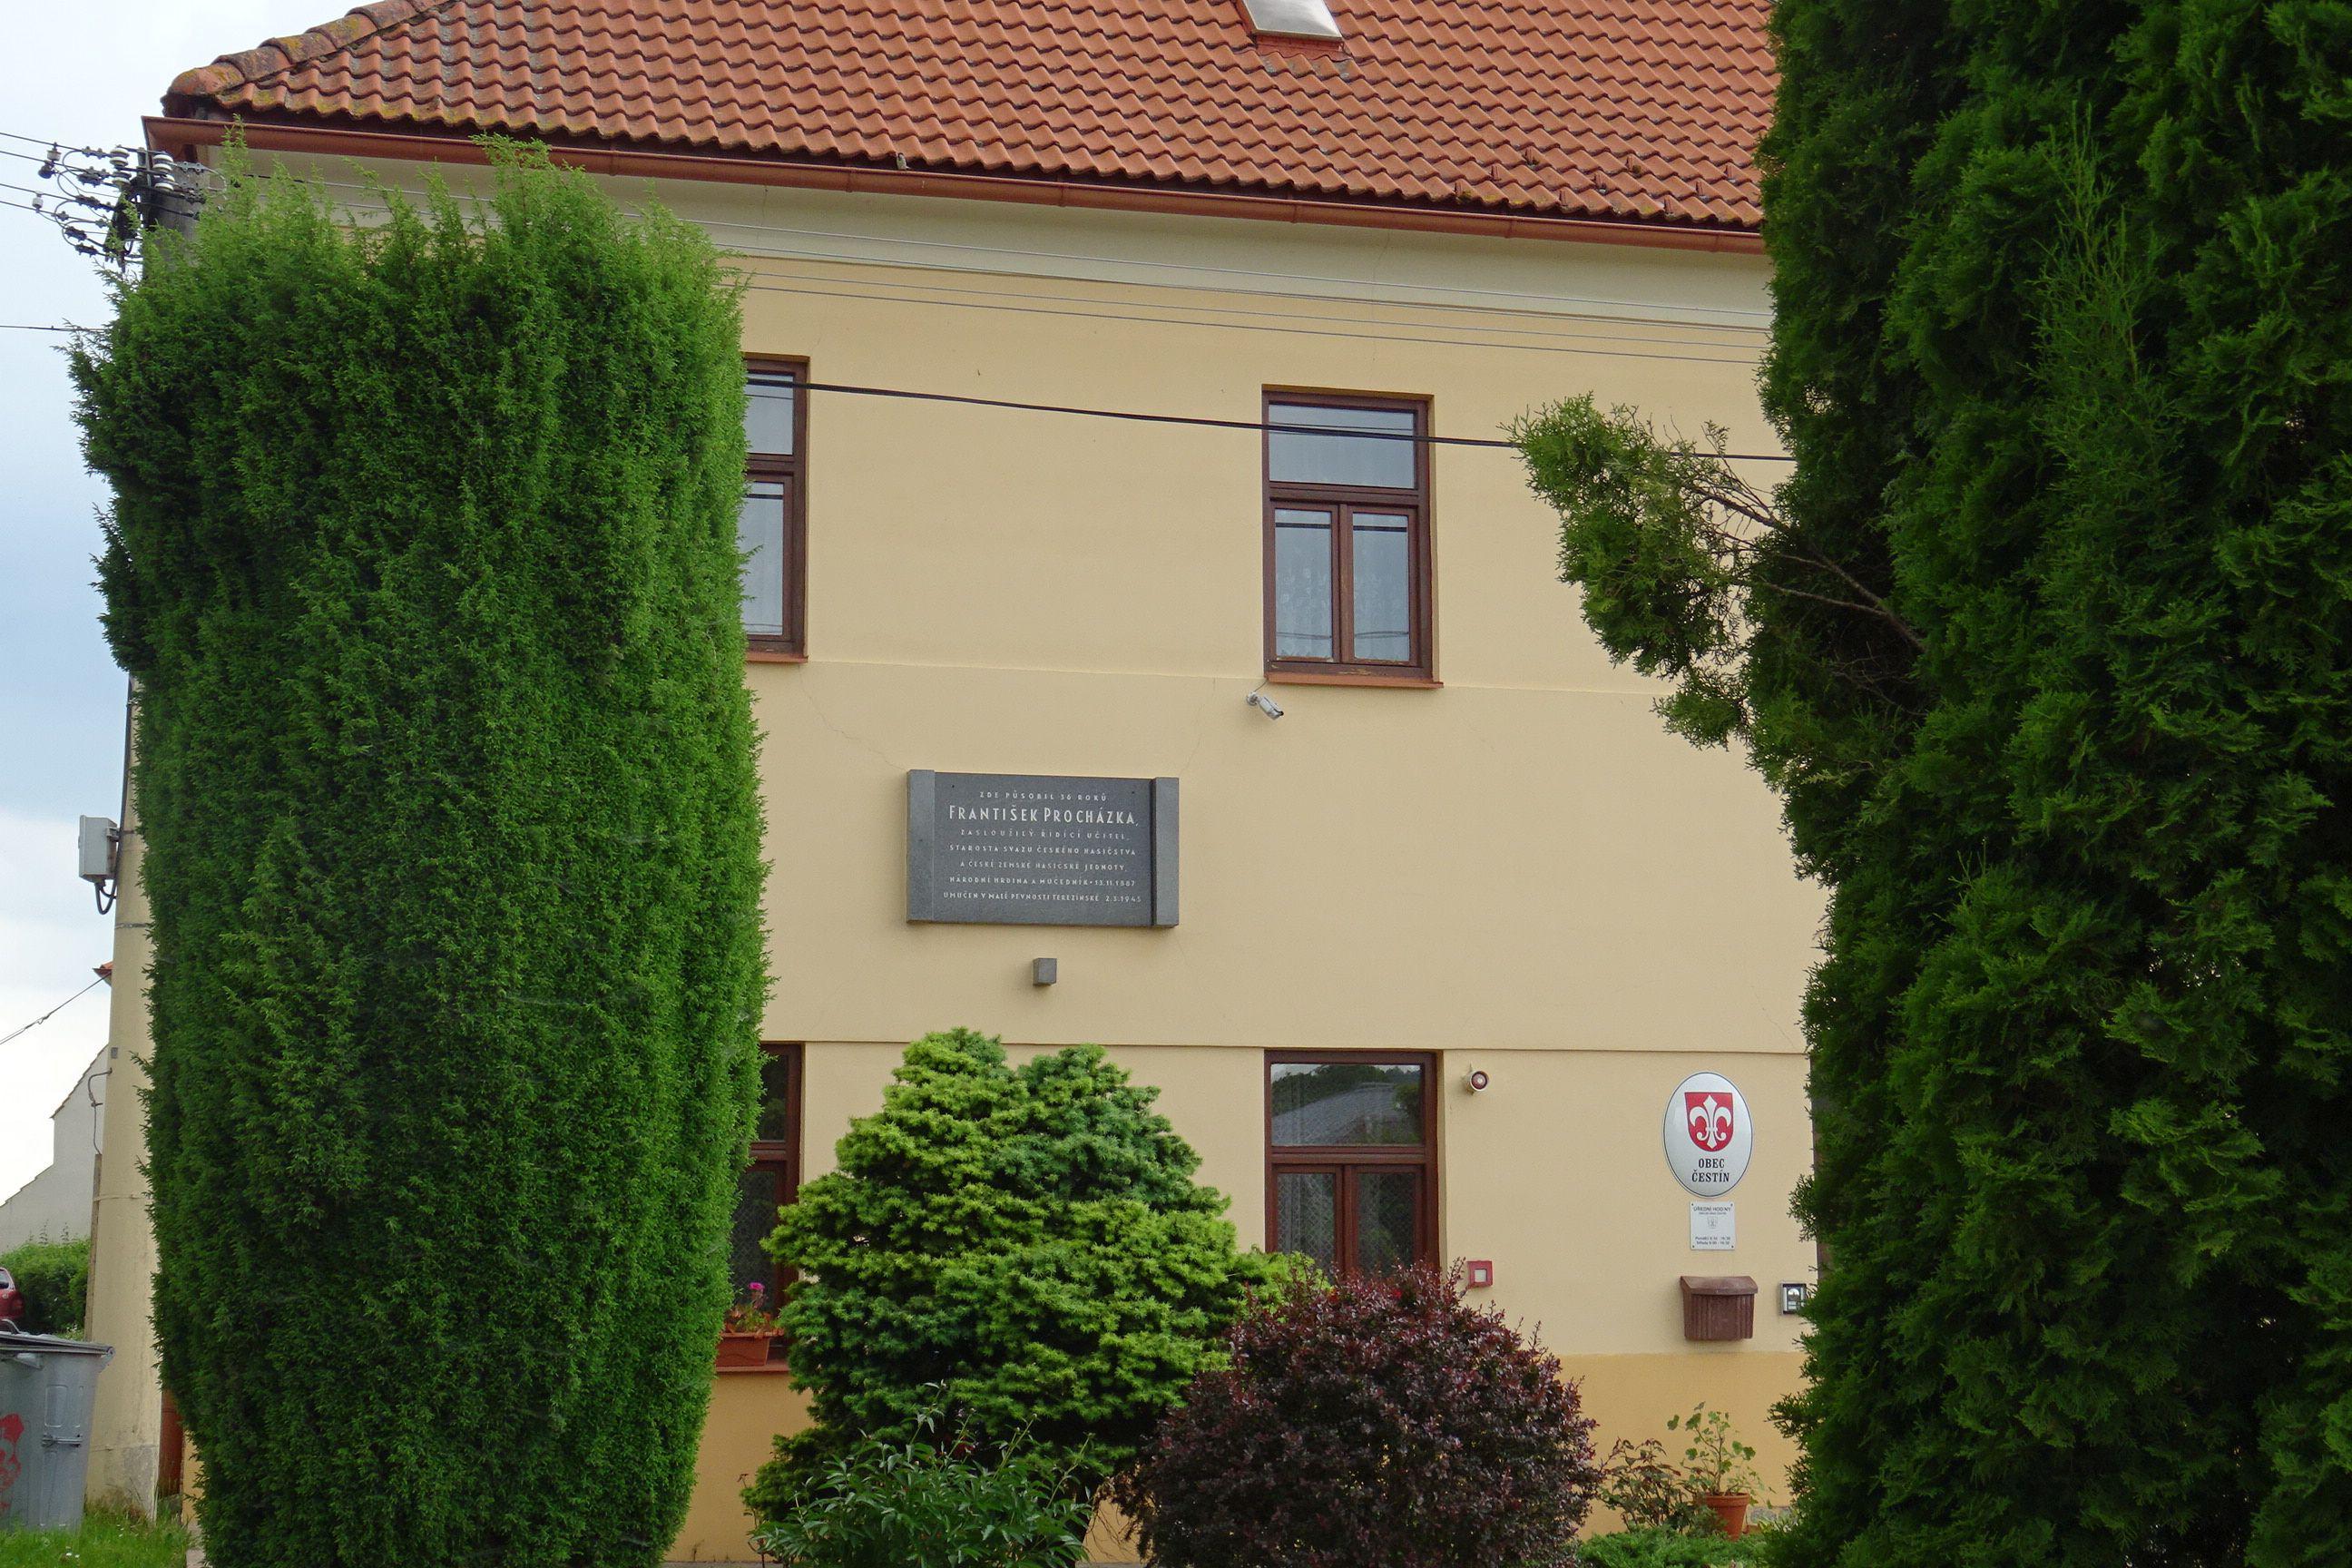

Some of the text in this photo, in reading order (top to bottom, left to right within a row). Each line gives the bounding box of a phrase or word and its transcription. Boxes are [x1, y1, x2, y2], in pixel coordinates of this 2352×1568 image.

[1005, 789, 1054, 800] PŮSOBIL
[1060, 793, 1072, 801] 36
[1077, 792, 1107, 802] ROKŮ
[949, 804, 1139, 827] FRANTIŠEK PROCHÁZKA,
[961, 828, 1034, 837] ZASLOUŽILÝ
[949, 844, 1136, 856] STAROSTA SVAZU ČESKÉHO HASIČSTVA
[968, 858, 995, 867] ČESKÉ
[998, 860, 1031, 868] ZEMSKÉ
[949, 873, 991, 883] NÁRODNÍ
[994, 877, 1028, 885] HRDINA
[944, 890, 978, 899] UMUČEN
[988, 891, 1009, 900] MALÉ
[1011, 892, 1051, 901] PEVNOSTI
[1053, 893, 1100, 902] TEREZÍNSKÉ
[1698, 1158, 1725, 1169] OBEC
[1691, 1169, 1730, 1182] ČESTÍN
